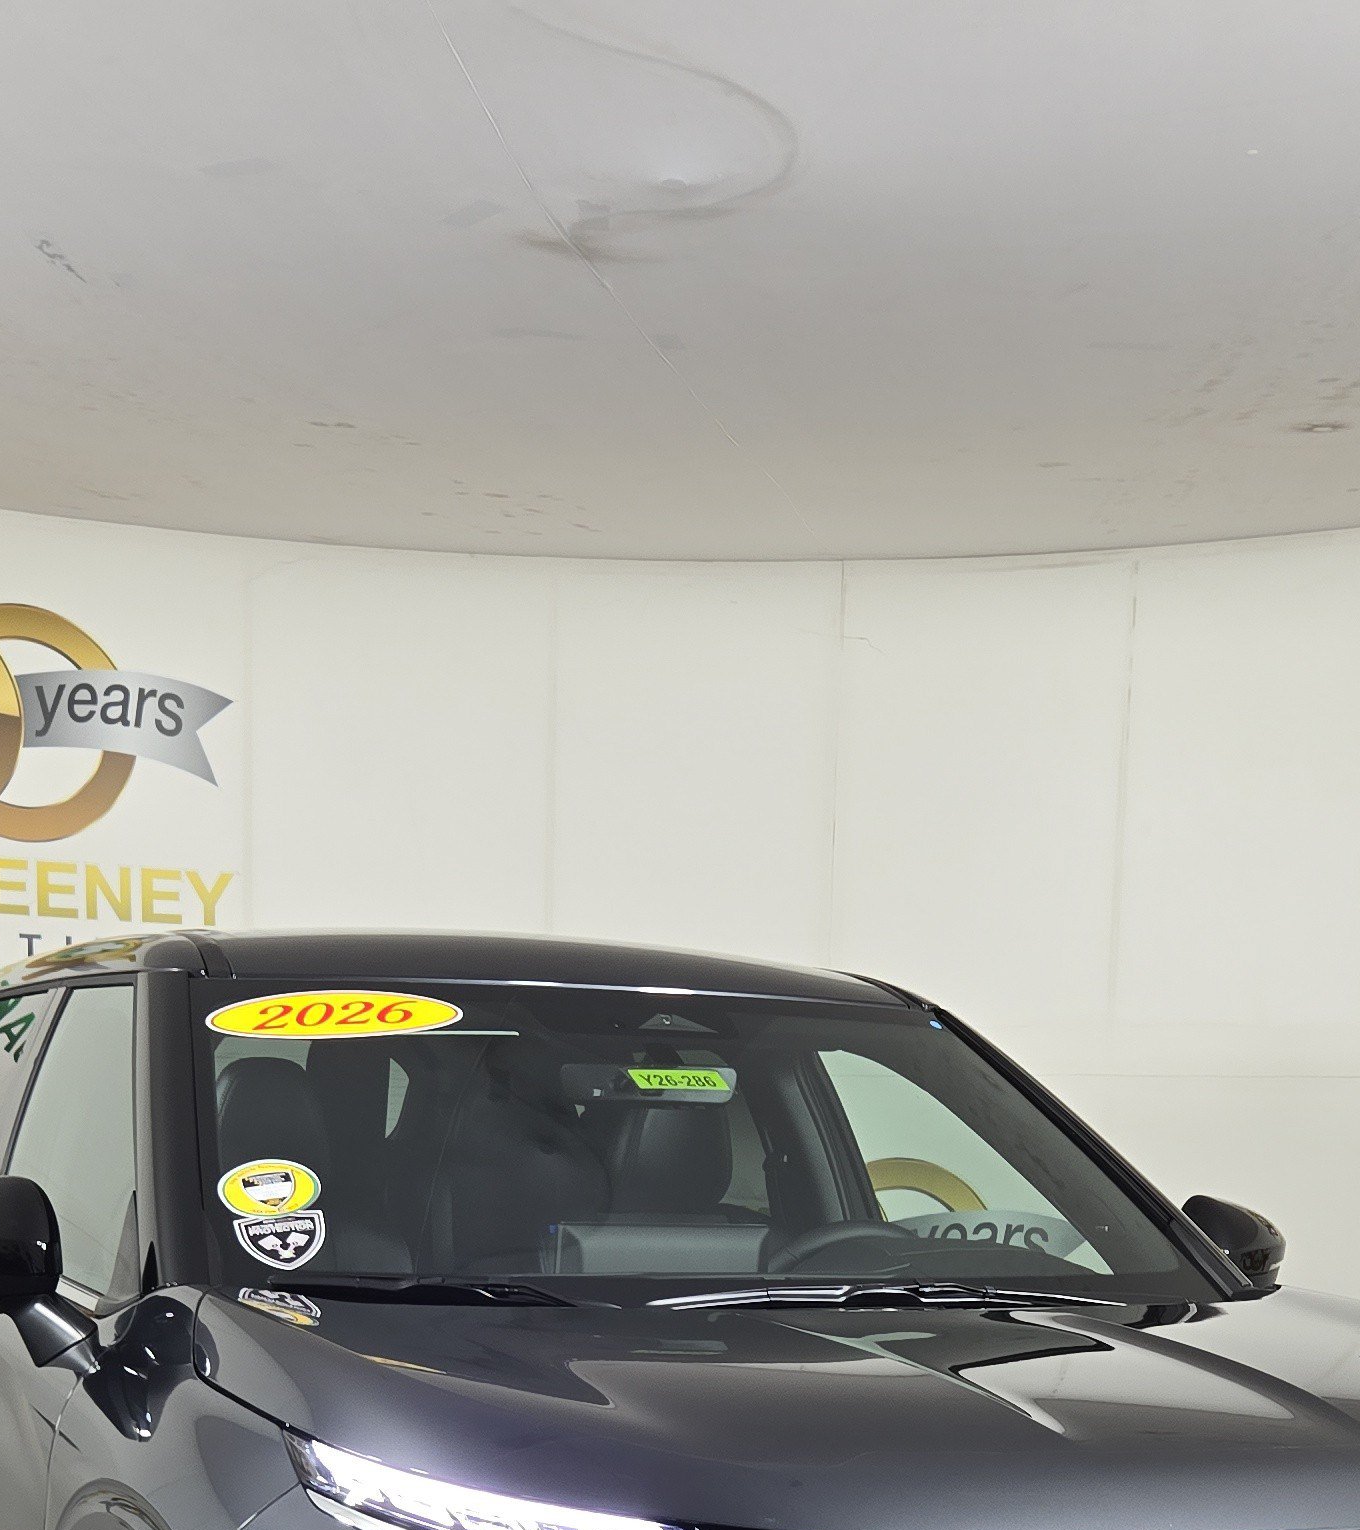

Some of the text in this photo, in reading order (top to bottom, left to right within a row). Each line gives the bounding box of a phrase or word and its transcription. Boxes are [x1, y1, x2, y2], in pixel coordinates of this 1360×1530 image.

[34, 680, 185, 737] years
[252, 1000, 414, 1032] 2026
[638, 1074, 717, 1088] Y26-286
